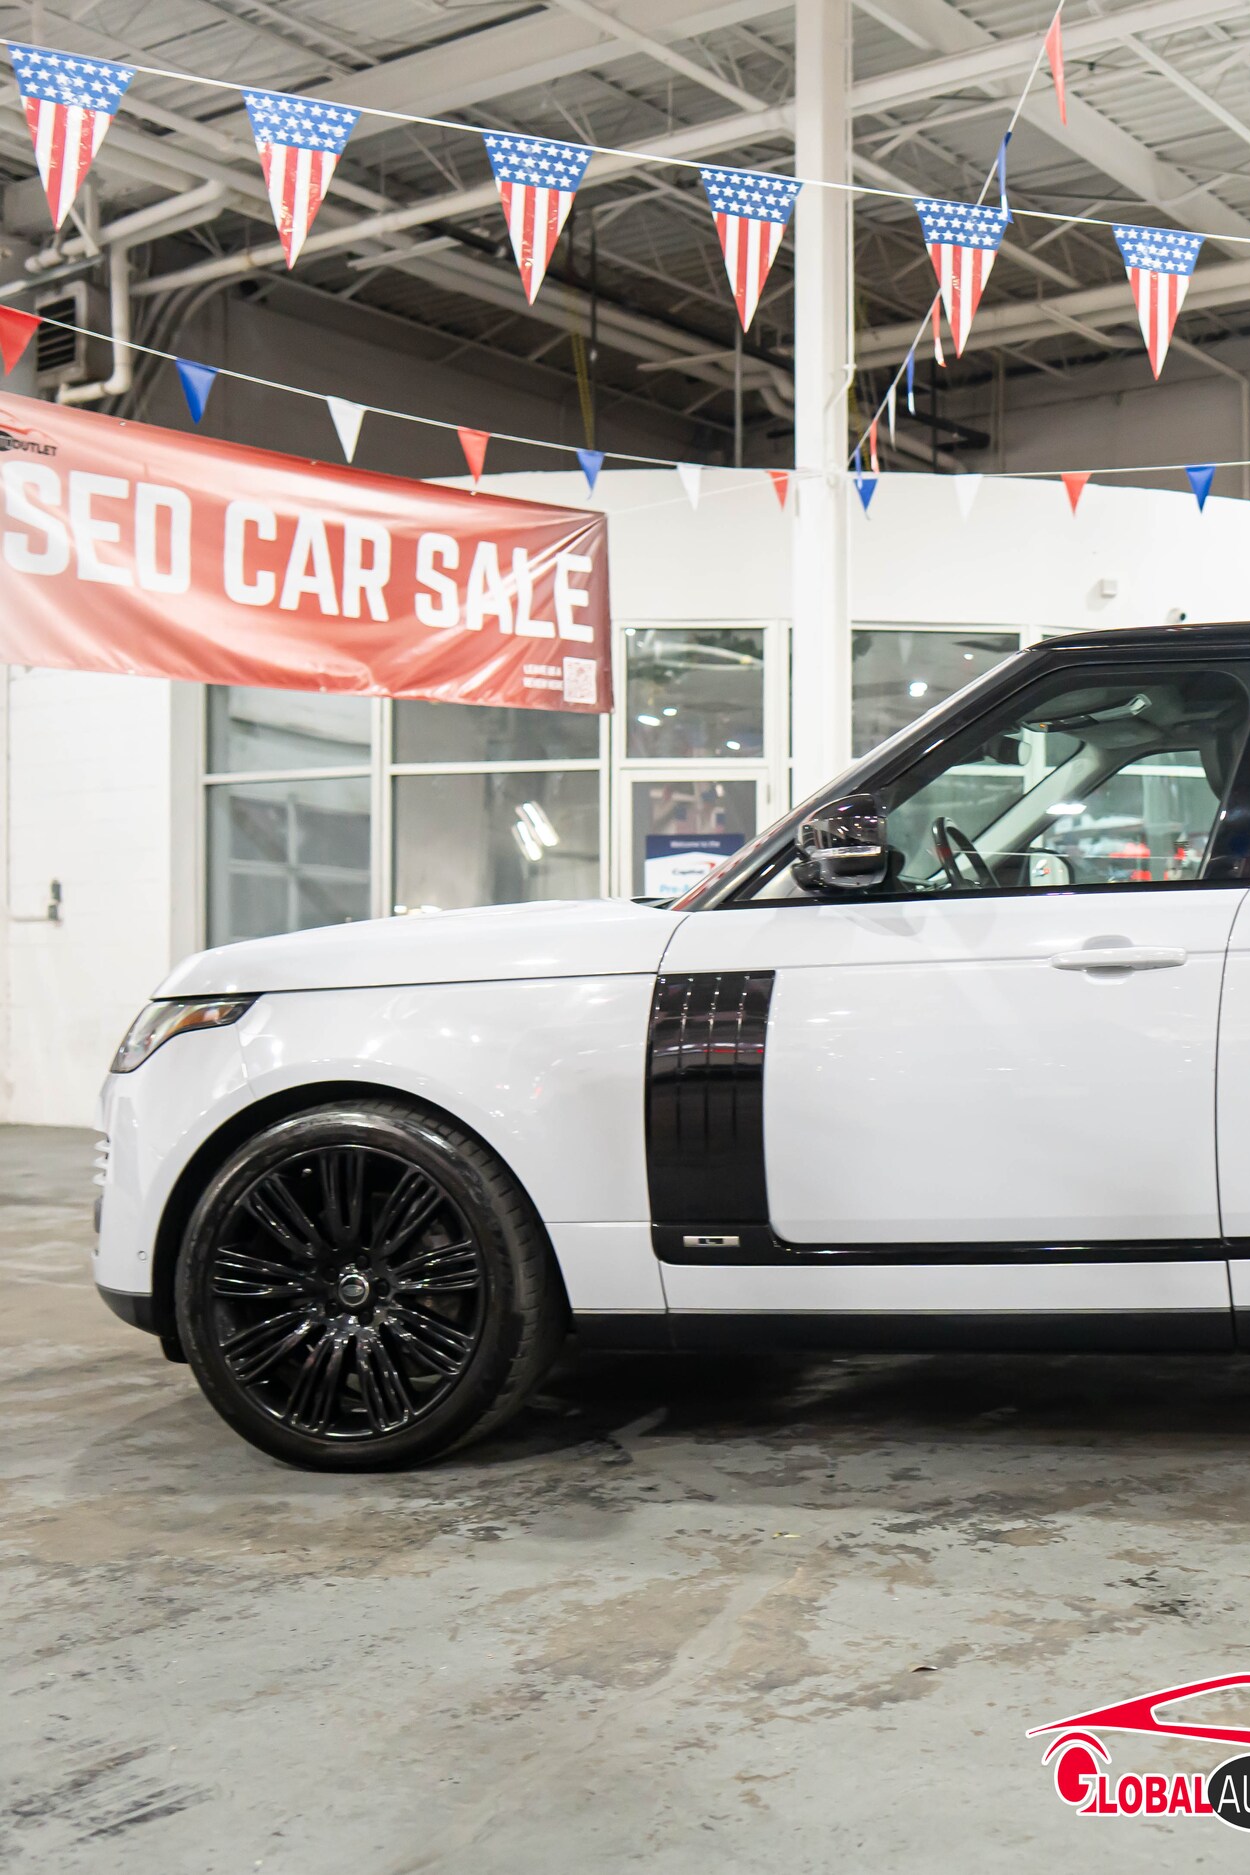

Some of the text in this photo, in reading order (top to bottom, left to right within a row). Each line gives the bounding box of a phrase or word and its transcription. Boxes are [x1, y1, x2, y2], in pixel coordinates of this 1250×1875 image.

[12, 439, 57, 456] OUTLET
[2, 460, 595, 643] SED CAR SALE
